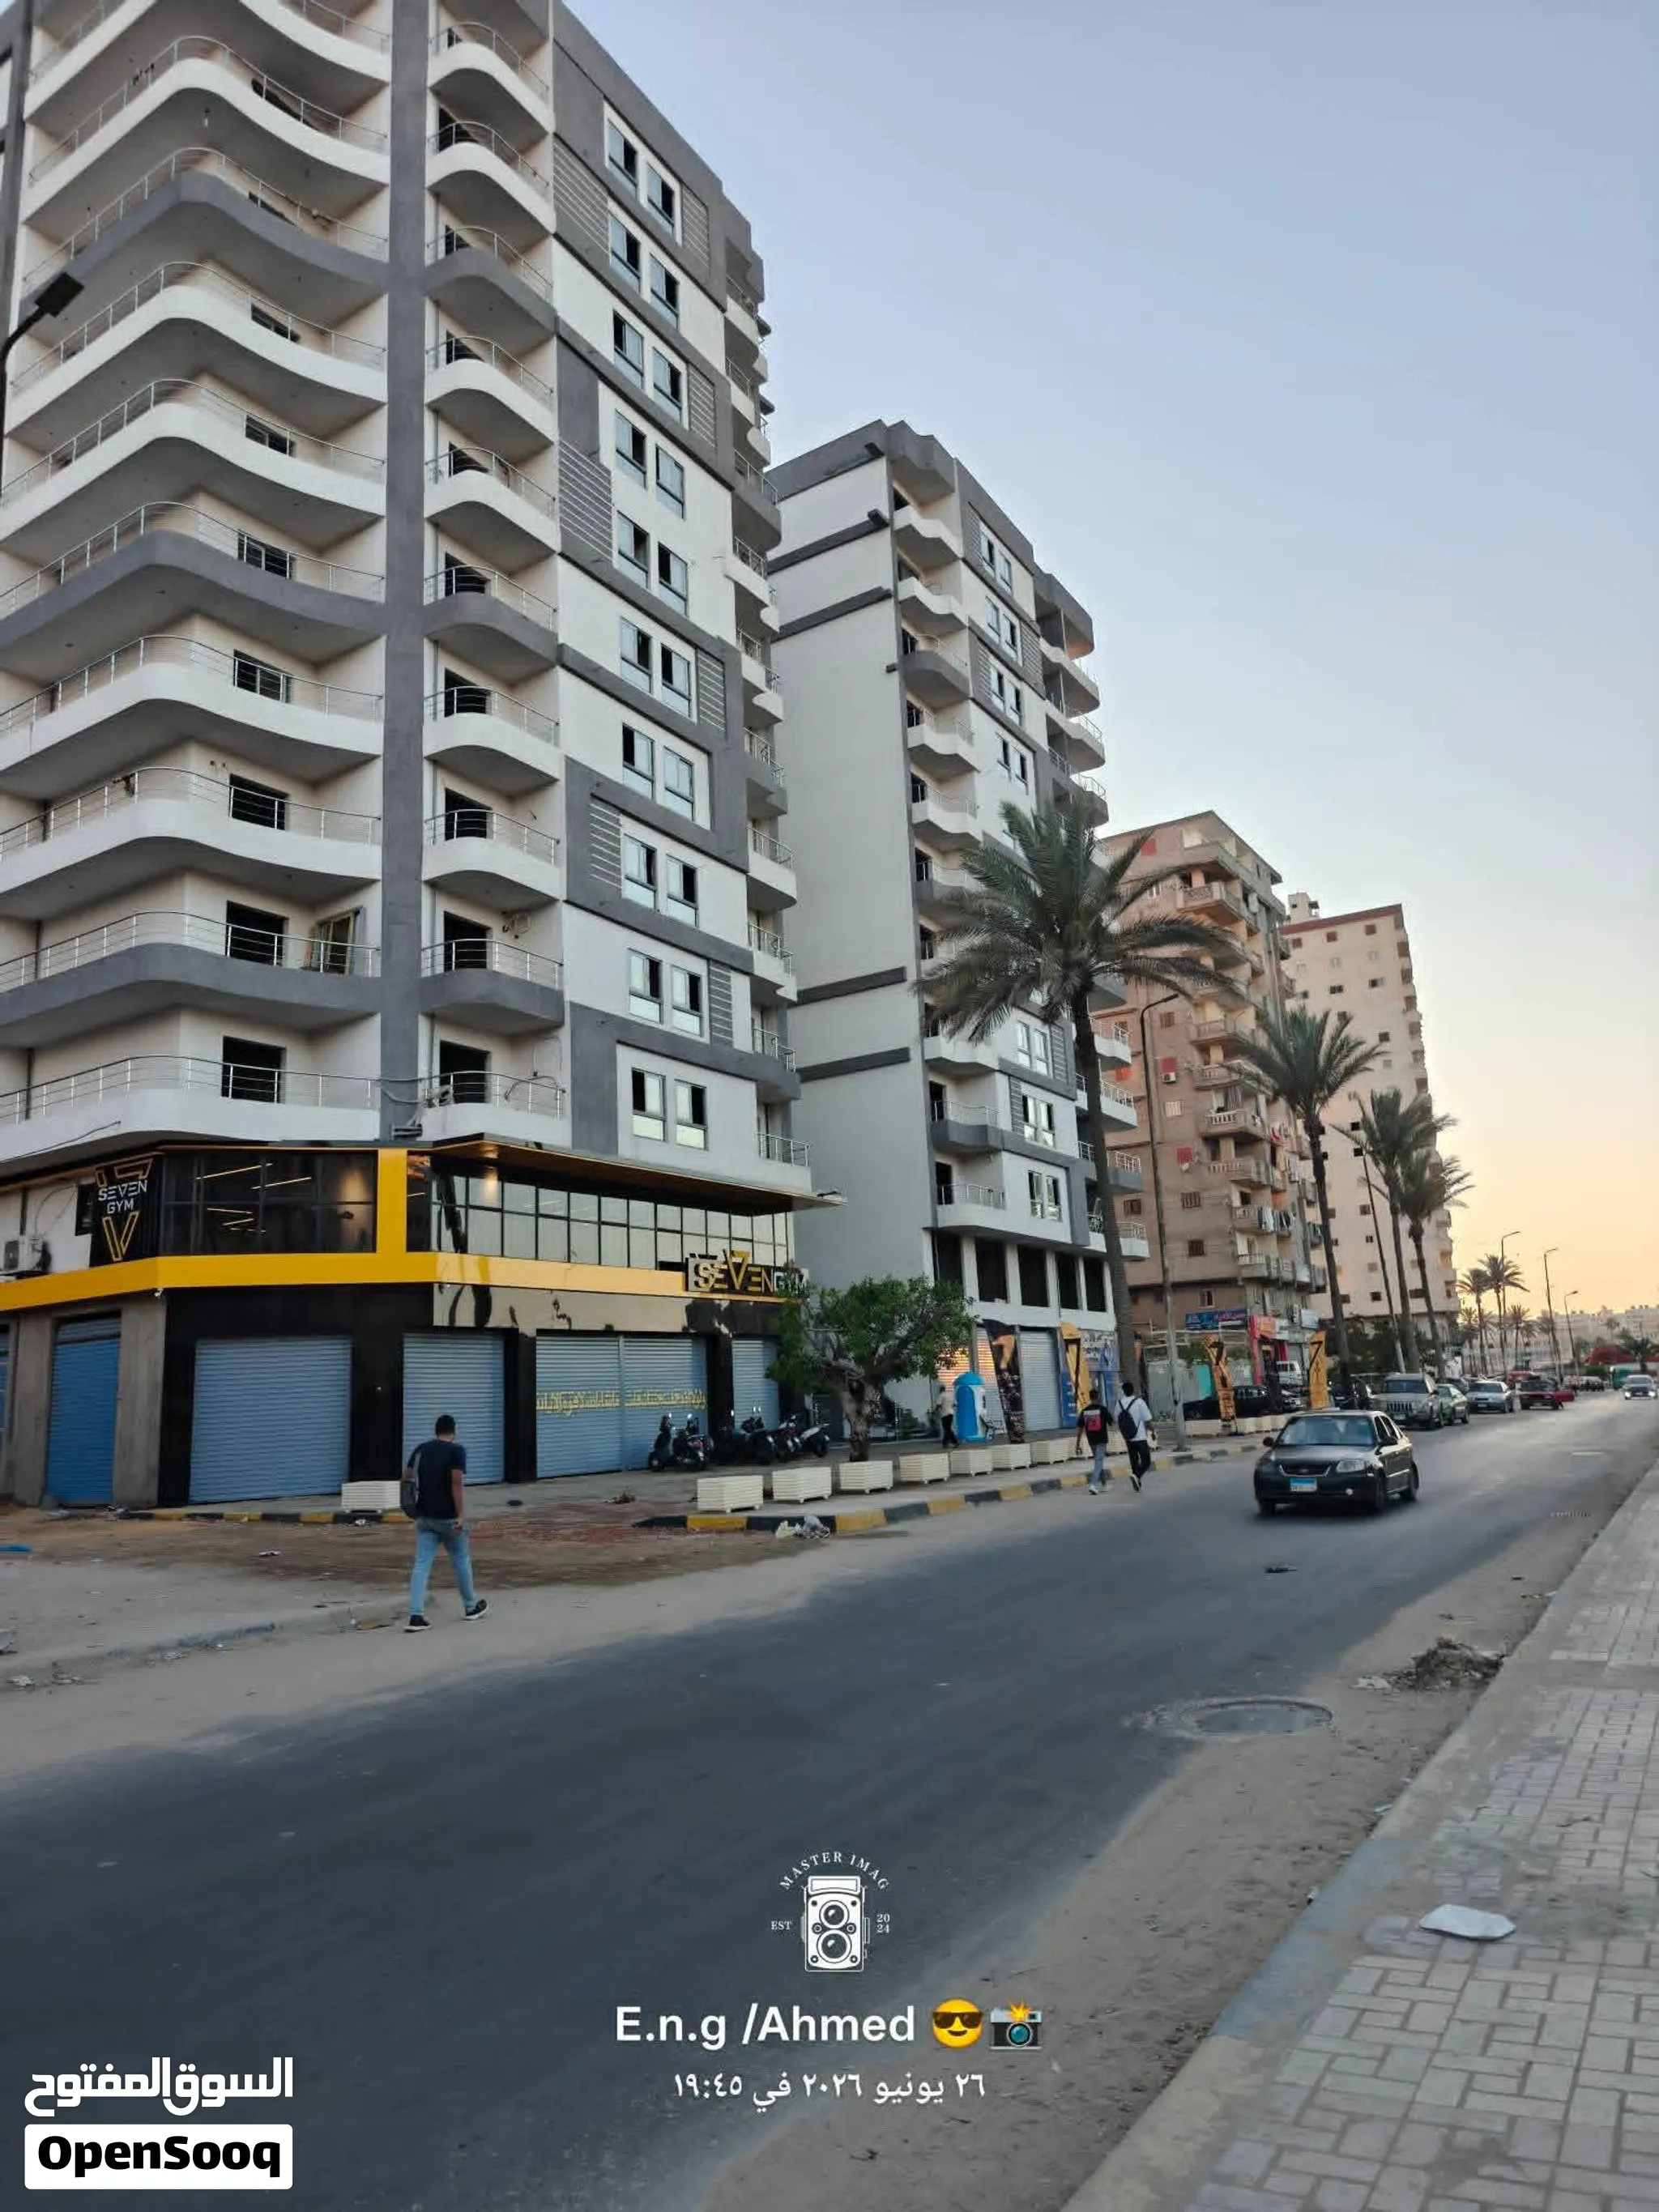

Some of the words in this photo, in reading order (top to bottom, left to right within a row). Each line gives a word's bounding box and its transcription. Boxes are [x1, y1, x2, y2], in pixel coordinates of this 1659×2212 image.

[98, 1179, 148, 1201] SEVEN
[107, 1199, 134, 1214] GYM
[694, 1249, 774, 1293] SEVEN
